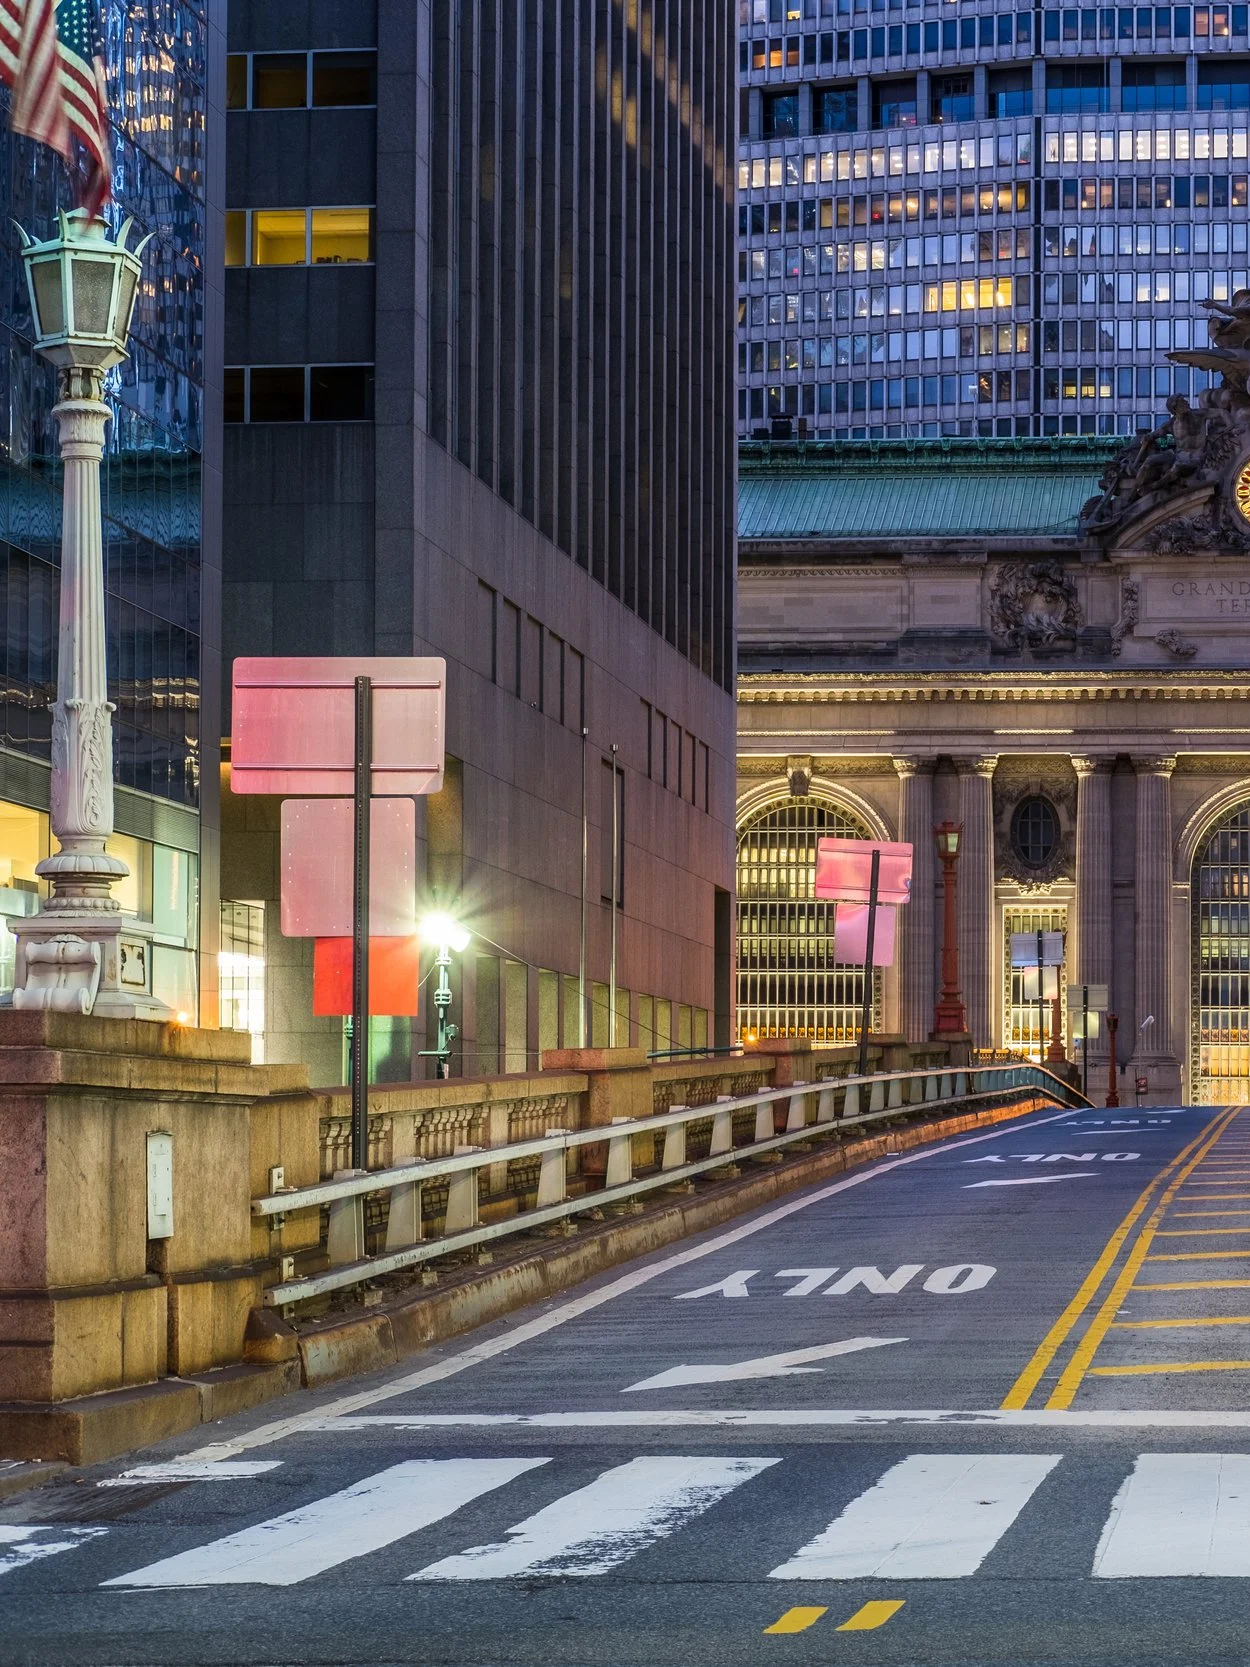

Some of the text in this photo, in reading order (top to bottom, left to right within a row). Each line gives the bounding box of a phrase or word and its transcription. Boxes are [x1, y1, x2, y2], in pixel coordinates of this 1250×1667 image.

[1172, 581, 1250, 596] GRAND
[961, 1152, 1142, 1163] ONLY
[673, 1263, 997, 1300] ONLY
